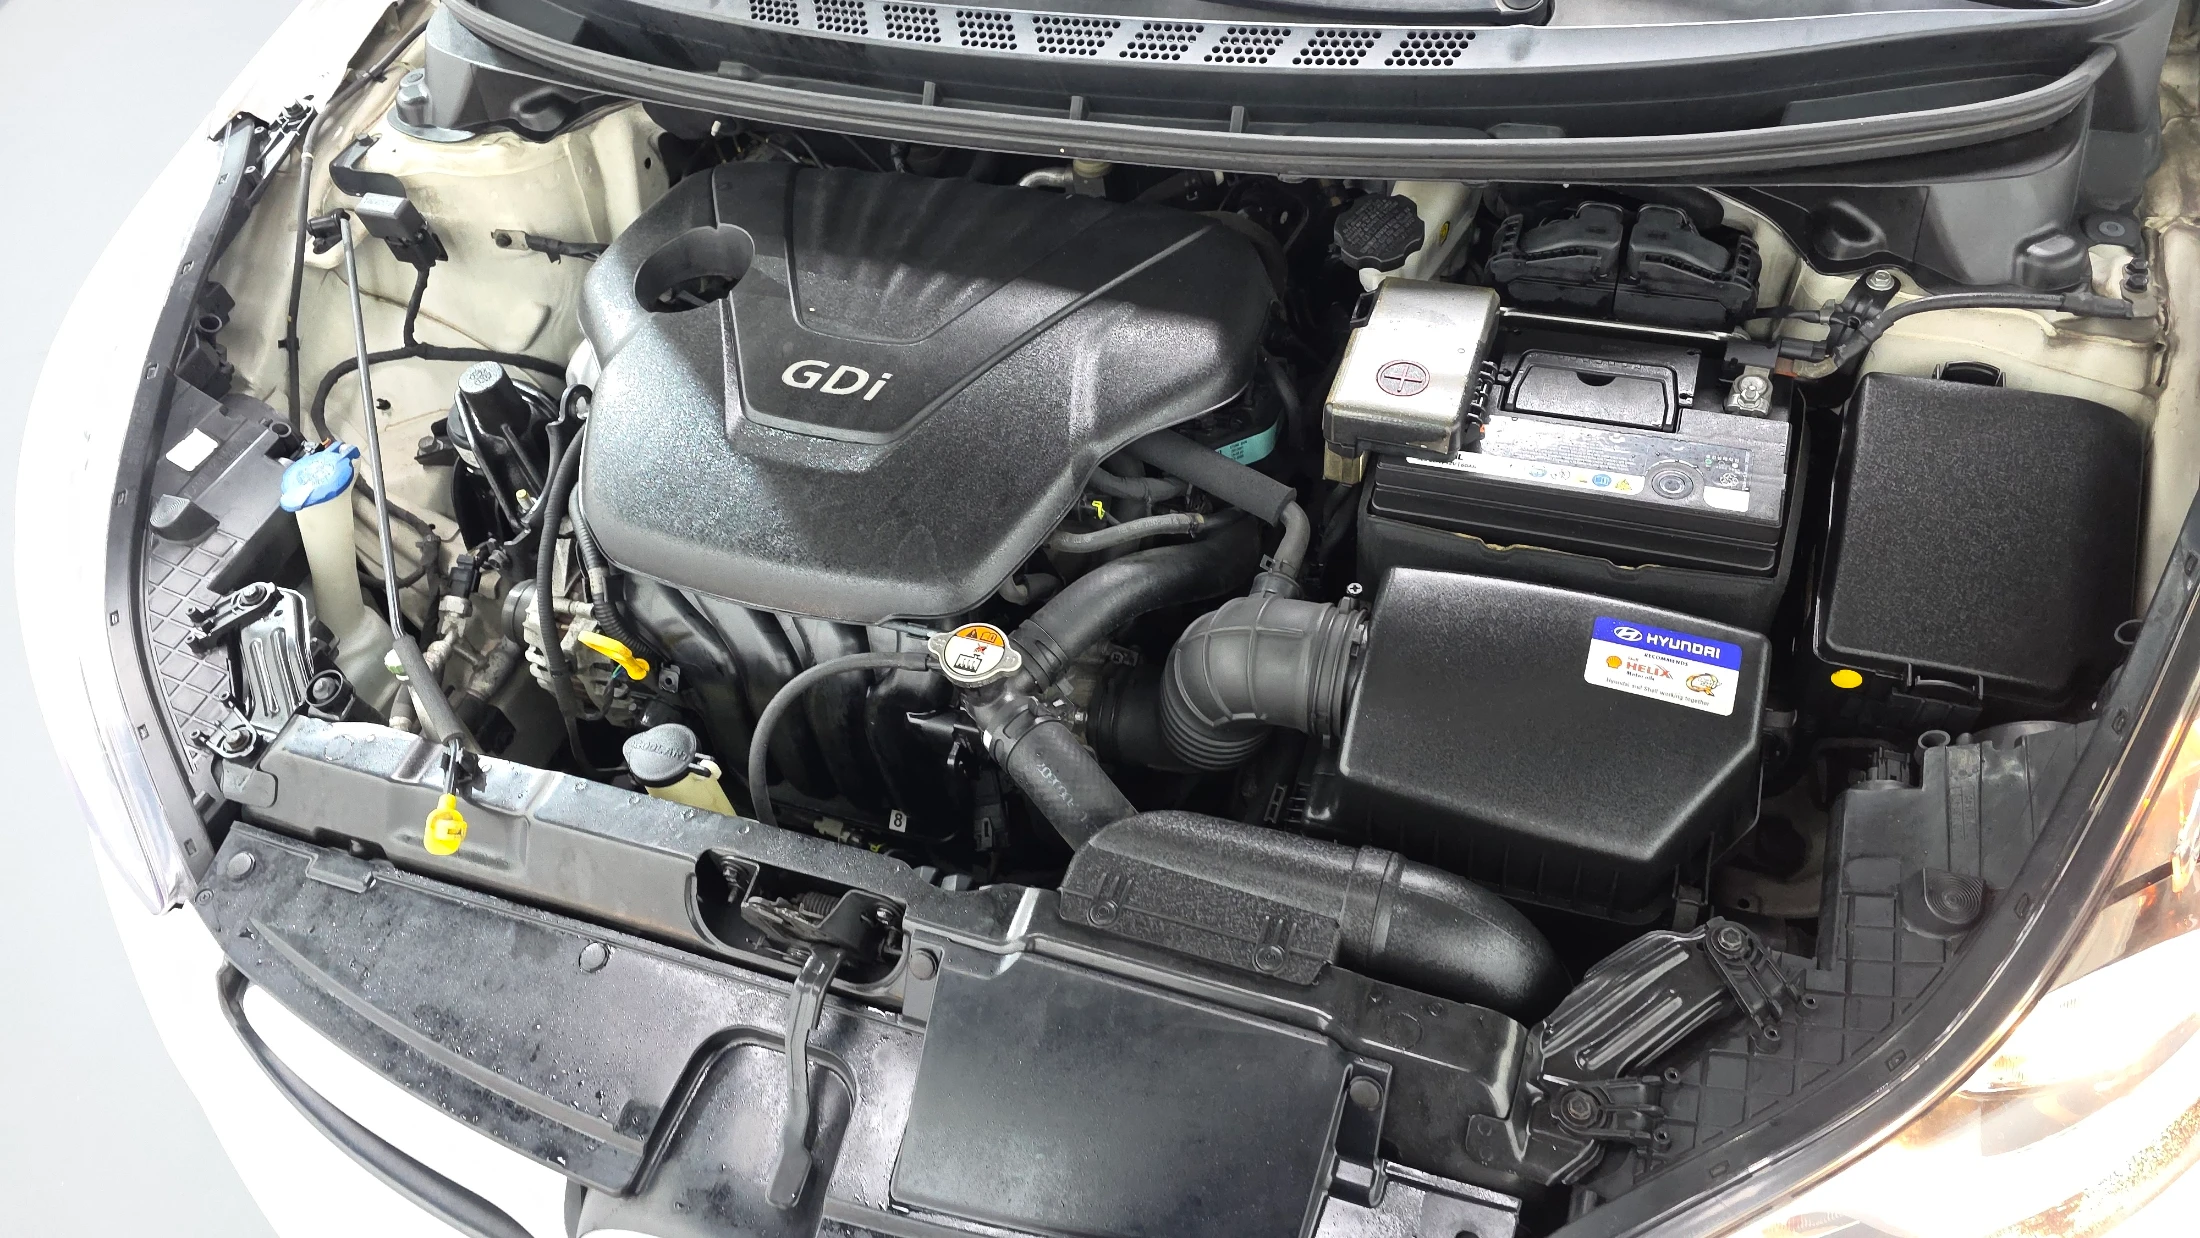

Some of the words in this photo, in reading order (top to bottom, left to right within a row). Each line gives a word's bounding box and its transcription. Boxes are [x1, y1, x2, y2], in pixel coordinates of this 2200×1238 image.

[782, 360, 893, 401] GDi
[1646, 633, 1721, 660] HYUNDAI
[1626, 661, 1672, 679] HELIX
[1644, 653, 1689, 667] RECOMMENDS
[1606, 677, 1630, 688] Hyundai
[1644, 686, 1659, 694] Shell
[1659, 690, 1684, 702] working
[1684, 695, 1710, 707] together
[632, 740, 689, 761] COOLANT
[893, 812, 903, 828] 8
